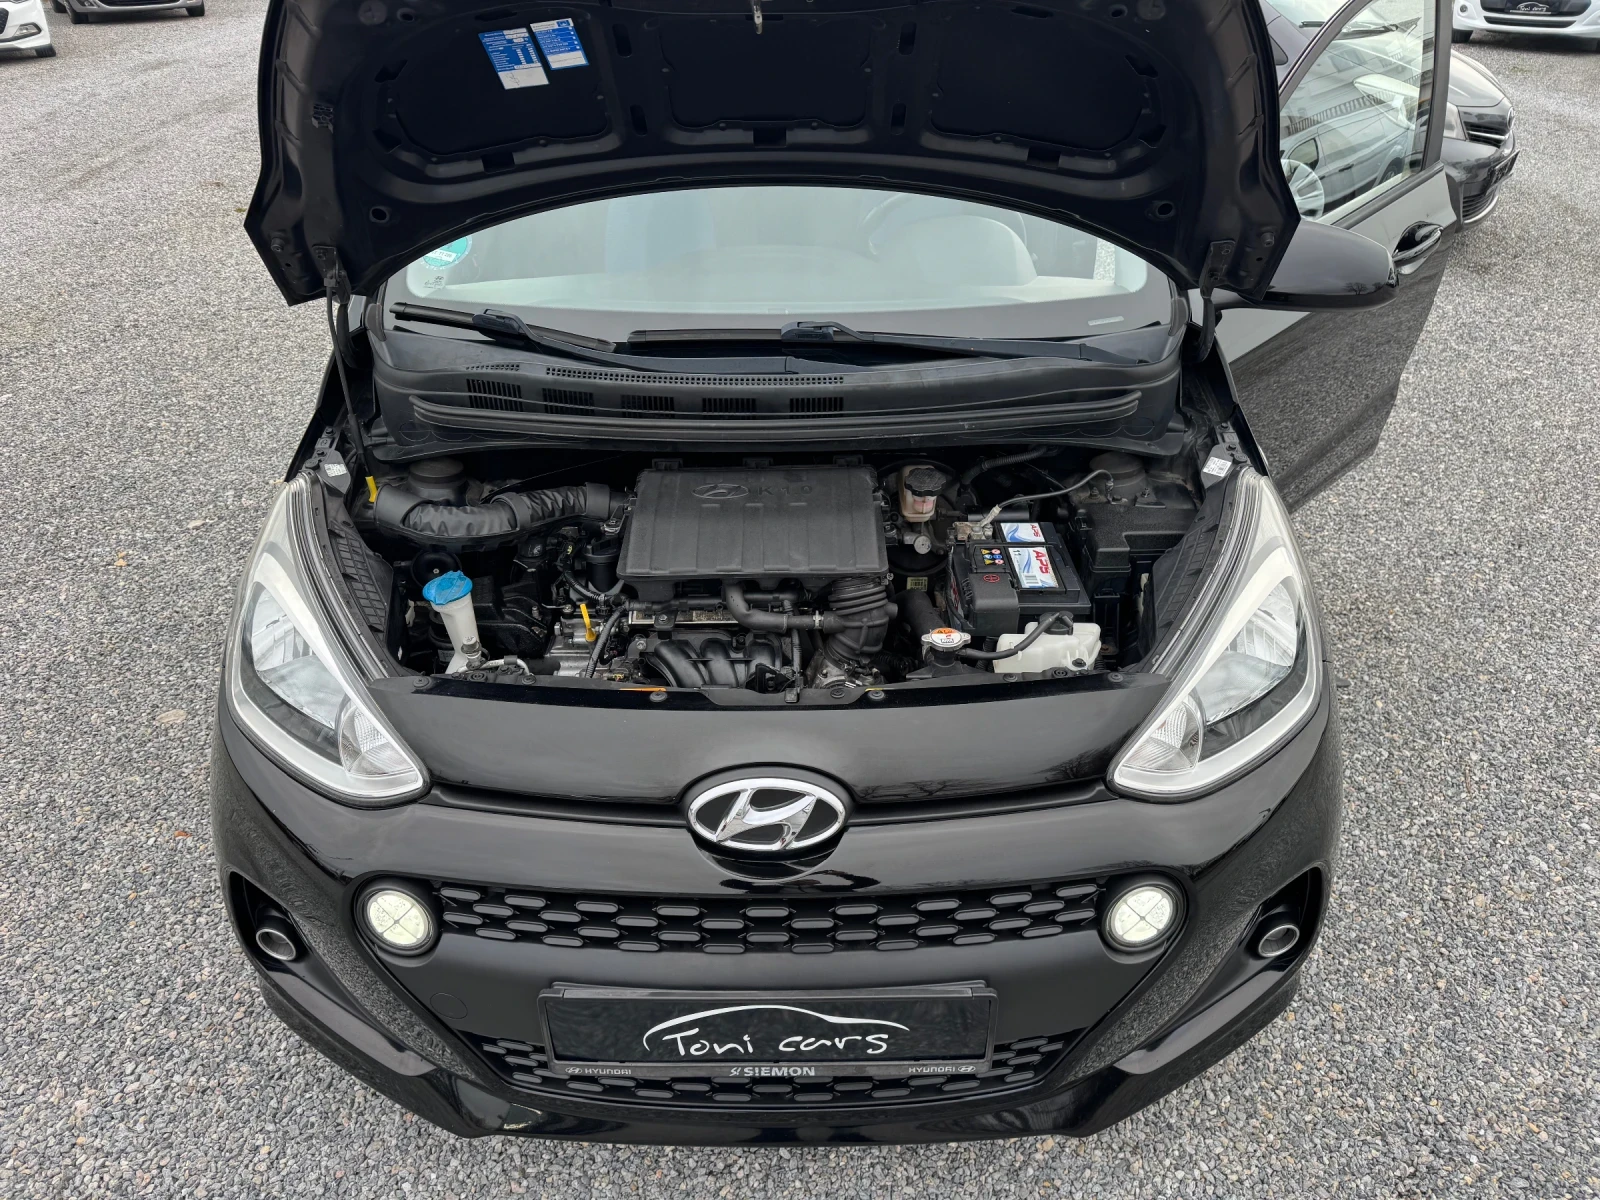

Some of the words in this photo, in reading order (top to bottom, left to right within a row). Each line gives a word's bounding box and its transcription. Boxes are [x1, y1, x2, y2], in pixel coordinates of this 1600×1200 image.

[1032, 549, 1051, 575] APS
[661, 1027, 754, 1056] Toni
[778, 1033, 889, 1054] cars
[584, 1067, 632, 1076] HYUNDAI
[908, 1066, 956, 1074] HYUNDAI
